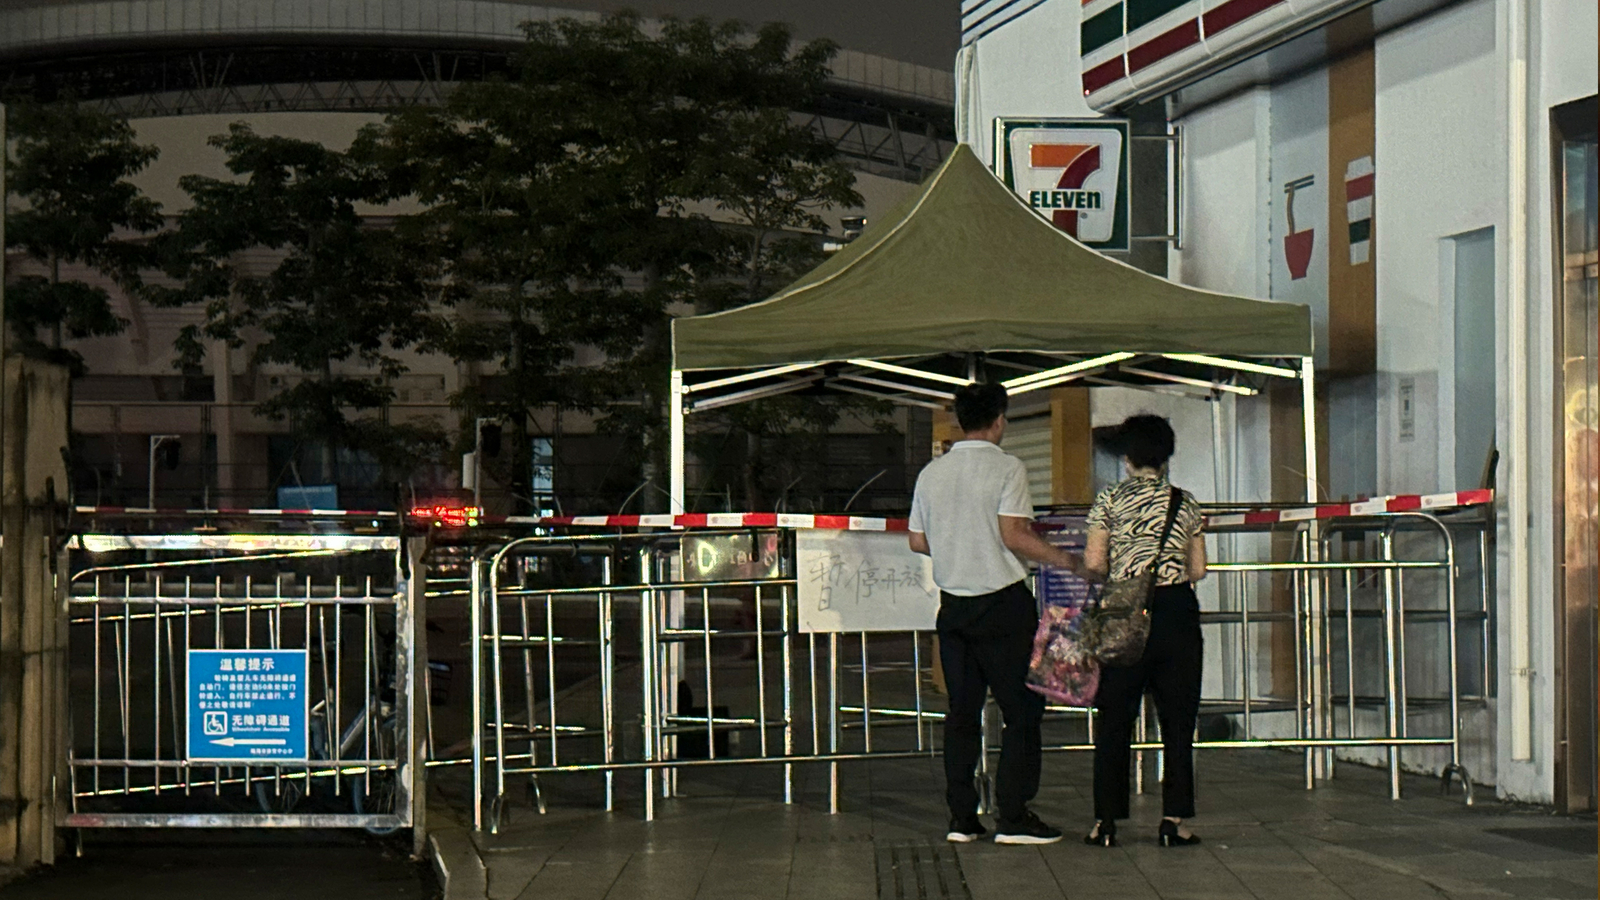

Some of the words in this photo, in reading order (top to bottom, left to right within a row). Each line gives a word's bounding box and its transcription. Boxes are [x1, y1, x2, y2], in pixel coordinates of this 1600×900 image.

[1030, 144, 1101, 239] 7
[807, 552, 933, 613] 暂停开放
[220, 658, 274, 671] 温馨提示
[232, 714, 290, 726] 无障碍通道
